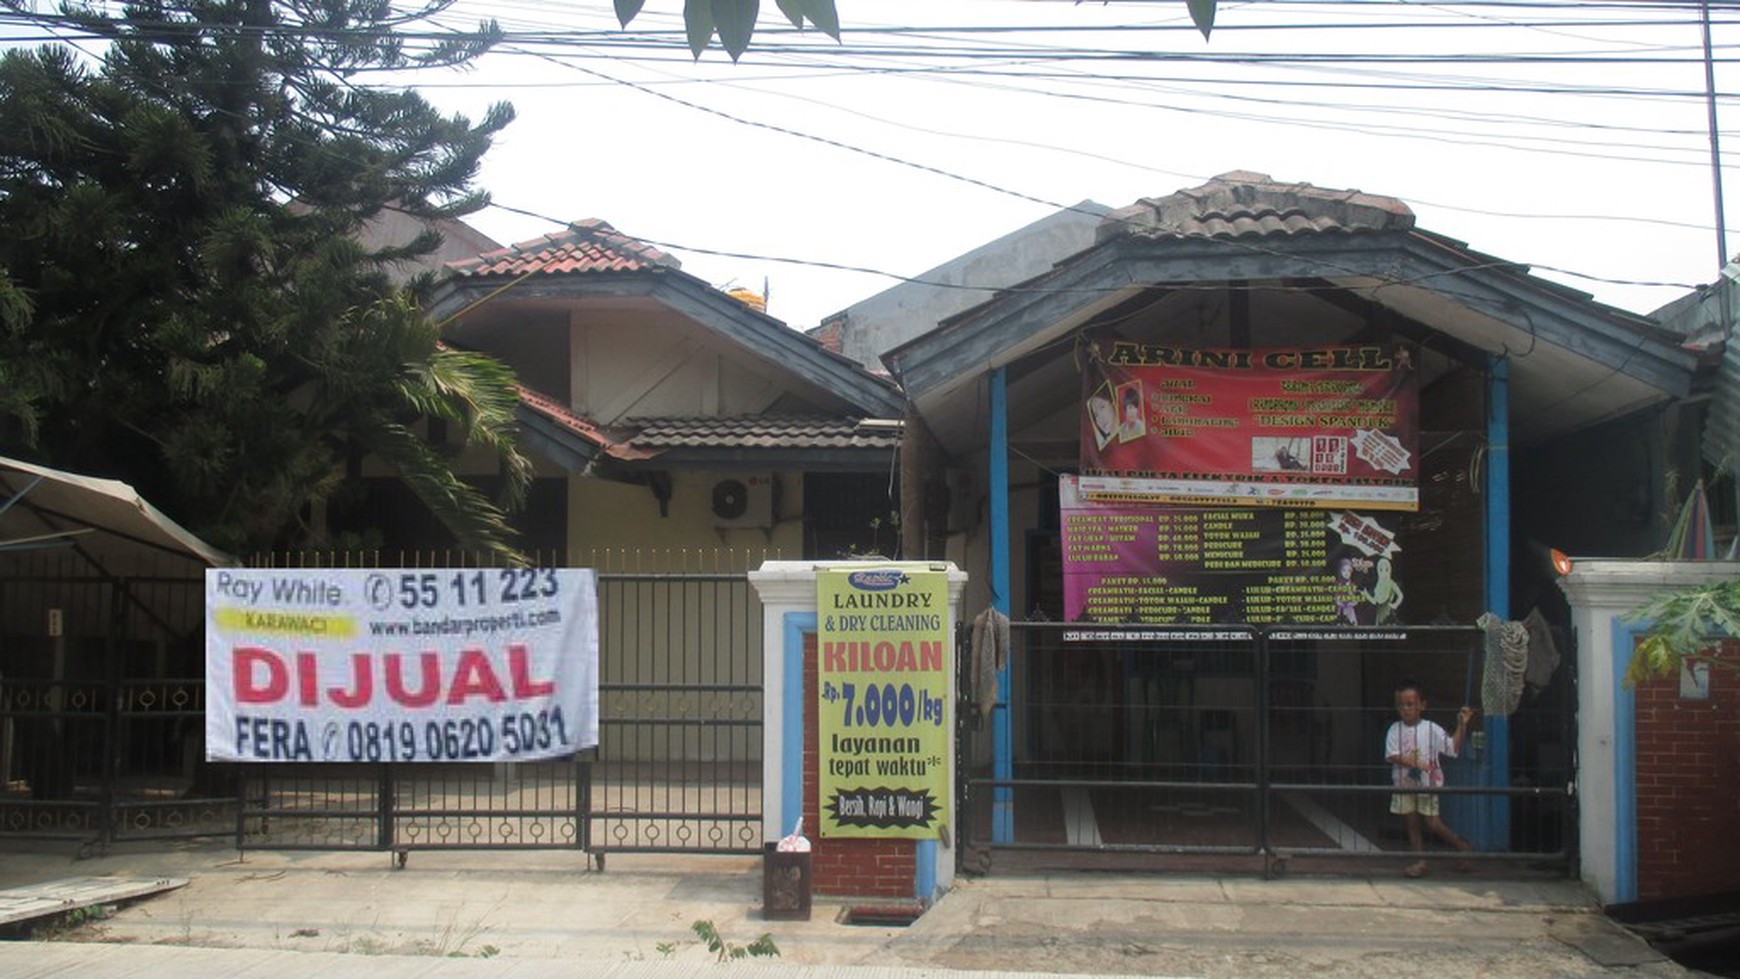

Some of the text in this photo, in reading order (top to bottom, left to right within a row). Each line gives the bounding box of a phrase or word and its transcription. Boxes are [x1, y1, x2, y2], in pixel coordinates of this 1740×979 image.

[1108, 341, 1392, 371] ARINI CELL
[217, 571, 341, 606] Ray White
[400, 568, 559, 609] 55 11 223
[833, 593, 932, 609] LAUNDRY
[246, 612, 327, 634] KARAWACI
[370, 609, 561, 637] www.bandarproperti.com
[825, 614, 941, 632] & DRY CLEANING
[823, 640, 943, 673] KILOAN
[232, 643, 555, 709] DIJUAL
[235, 716, 314, 760] FERA
[347, 705, 568, 762] 0819 0620 5031
[832, 733, 920, 756] layanan
[829, 757, 870, 778] tepat
[888, 796, 896, 816] &
[897, 795, 924, 819] Wangi
